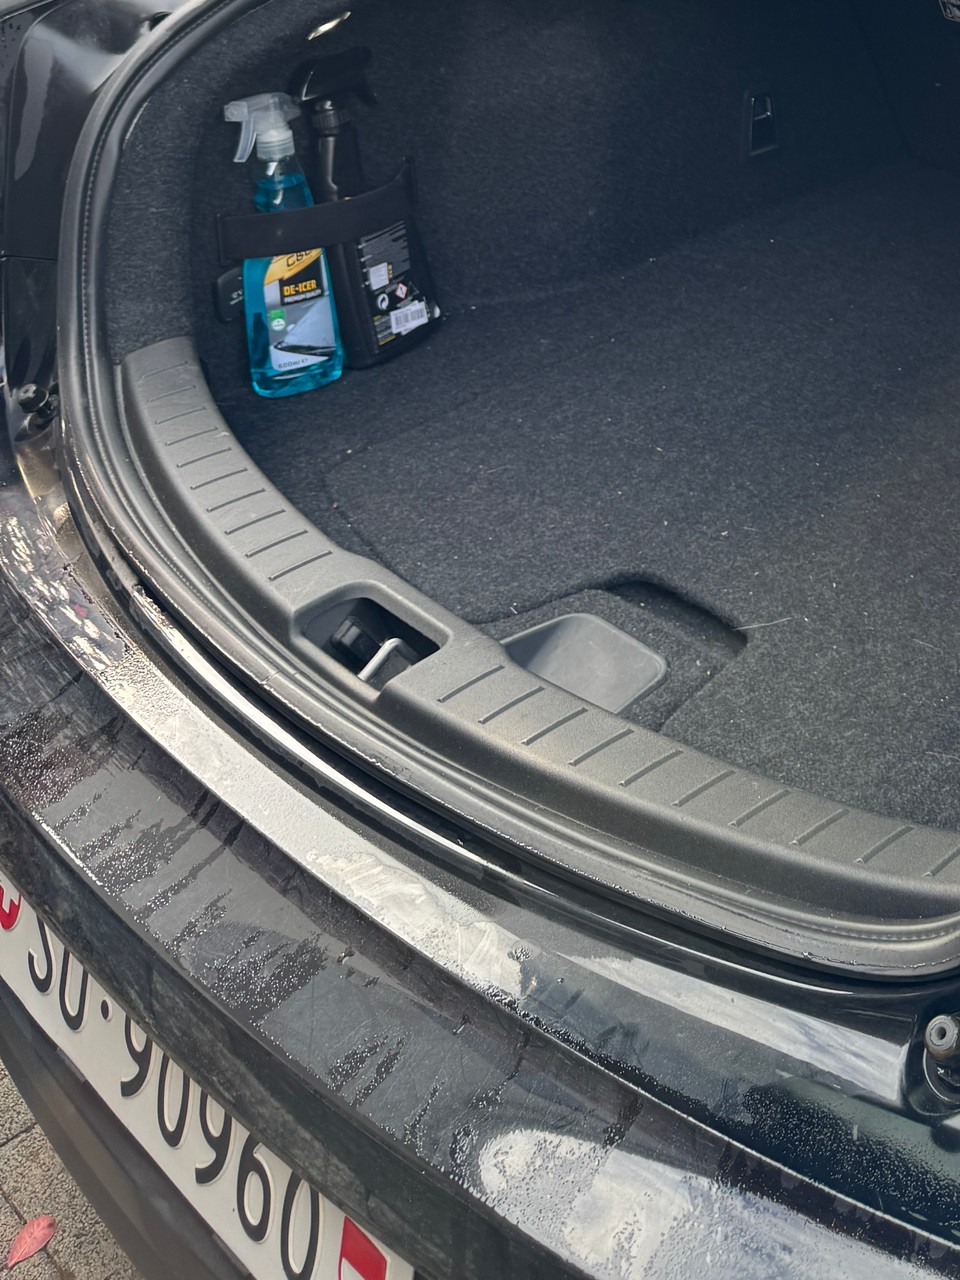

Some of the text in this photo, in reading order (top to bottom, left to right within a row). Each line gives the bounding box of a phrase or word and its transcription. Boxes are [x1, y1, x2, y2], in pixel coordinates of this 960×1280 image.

[284, 280, 317, 296] DE-ICER
[284, 289, 322, 303] PREMIUM QUALITY
